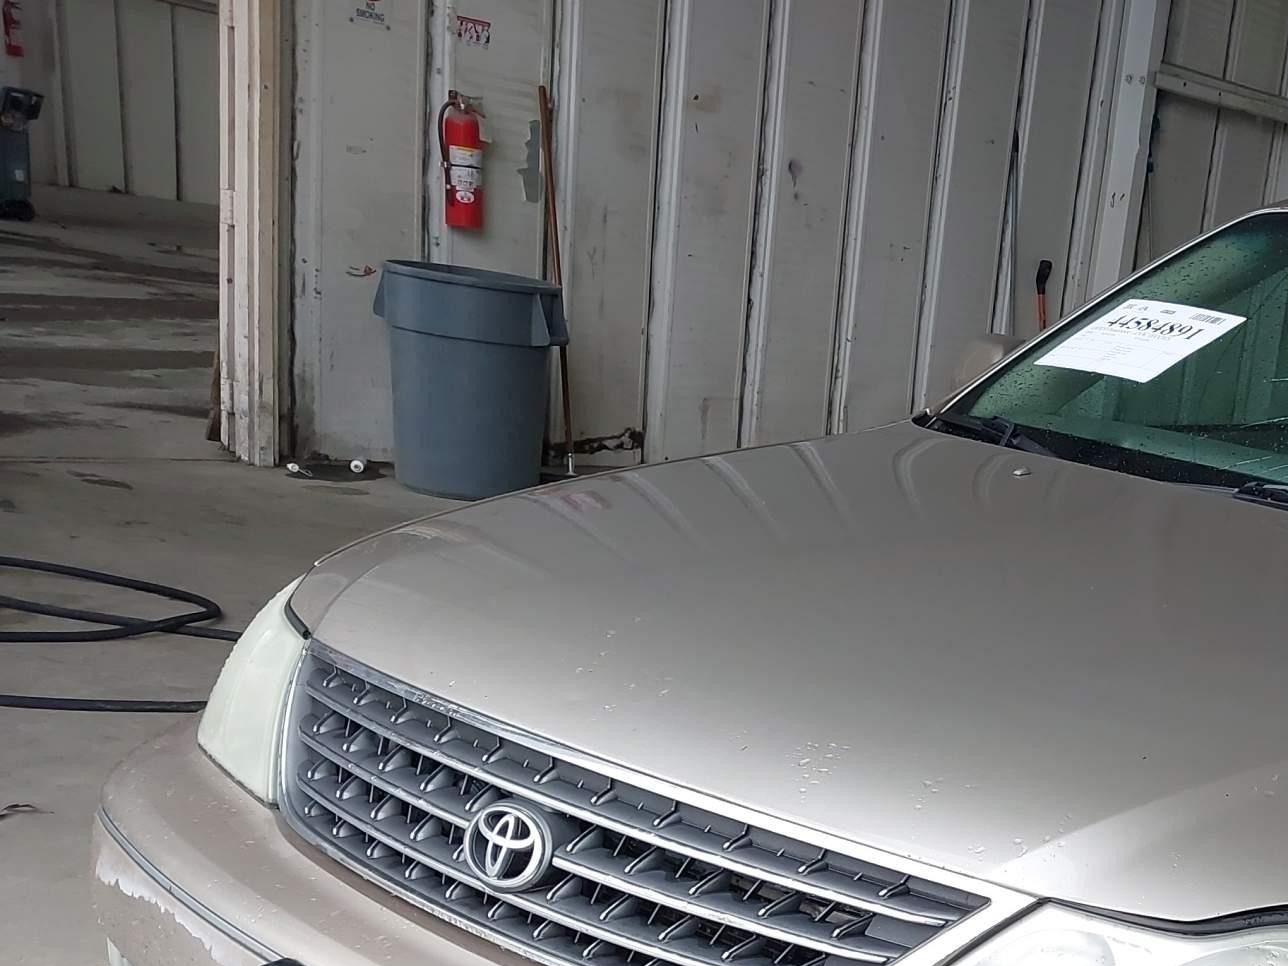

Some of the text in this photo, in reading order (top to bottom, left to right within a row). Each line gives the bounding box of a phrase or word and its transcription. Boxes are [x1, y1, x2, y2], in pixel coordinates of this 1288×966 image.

[366, 2, 376, 11] NO
[356, 7, 385, 22] SMOKING
[1107, 314, 1205, 340] 44584891
